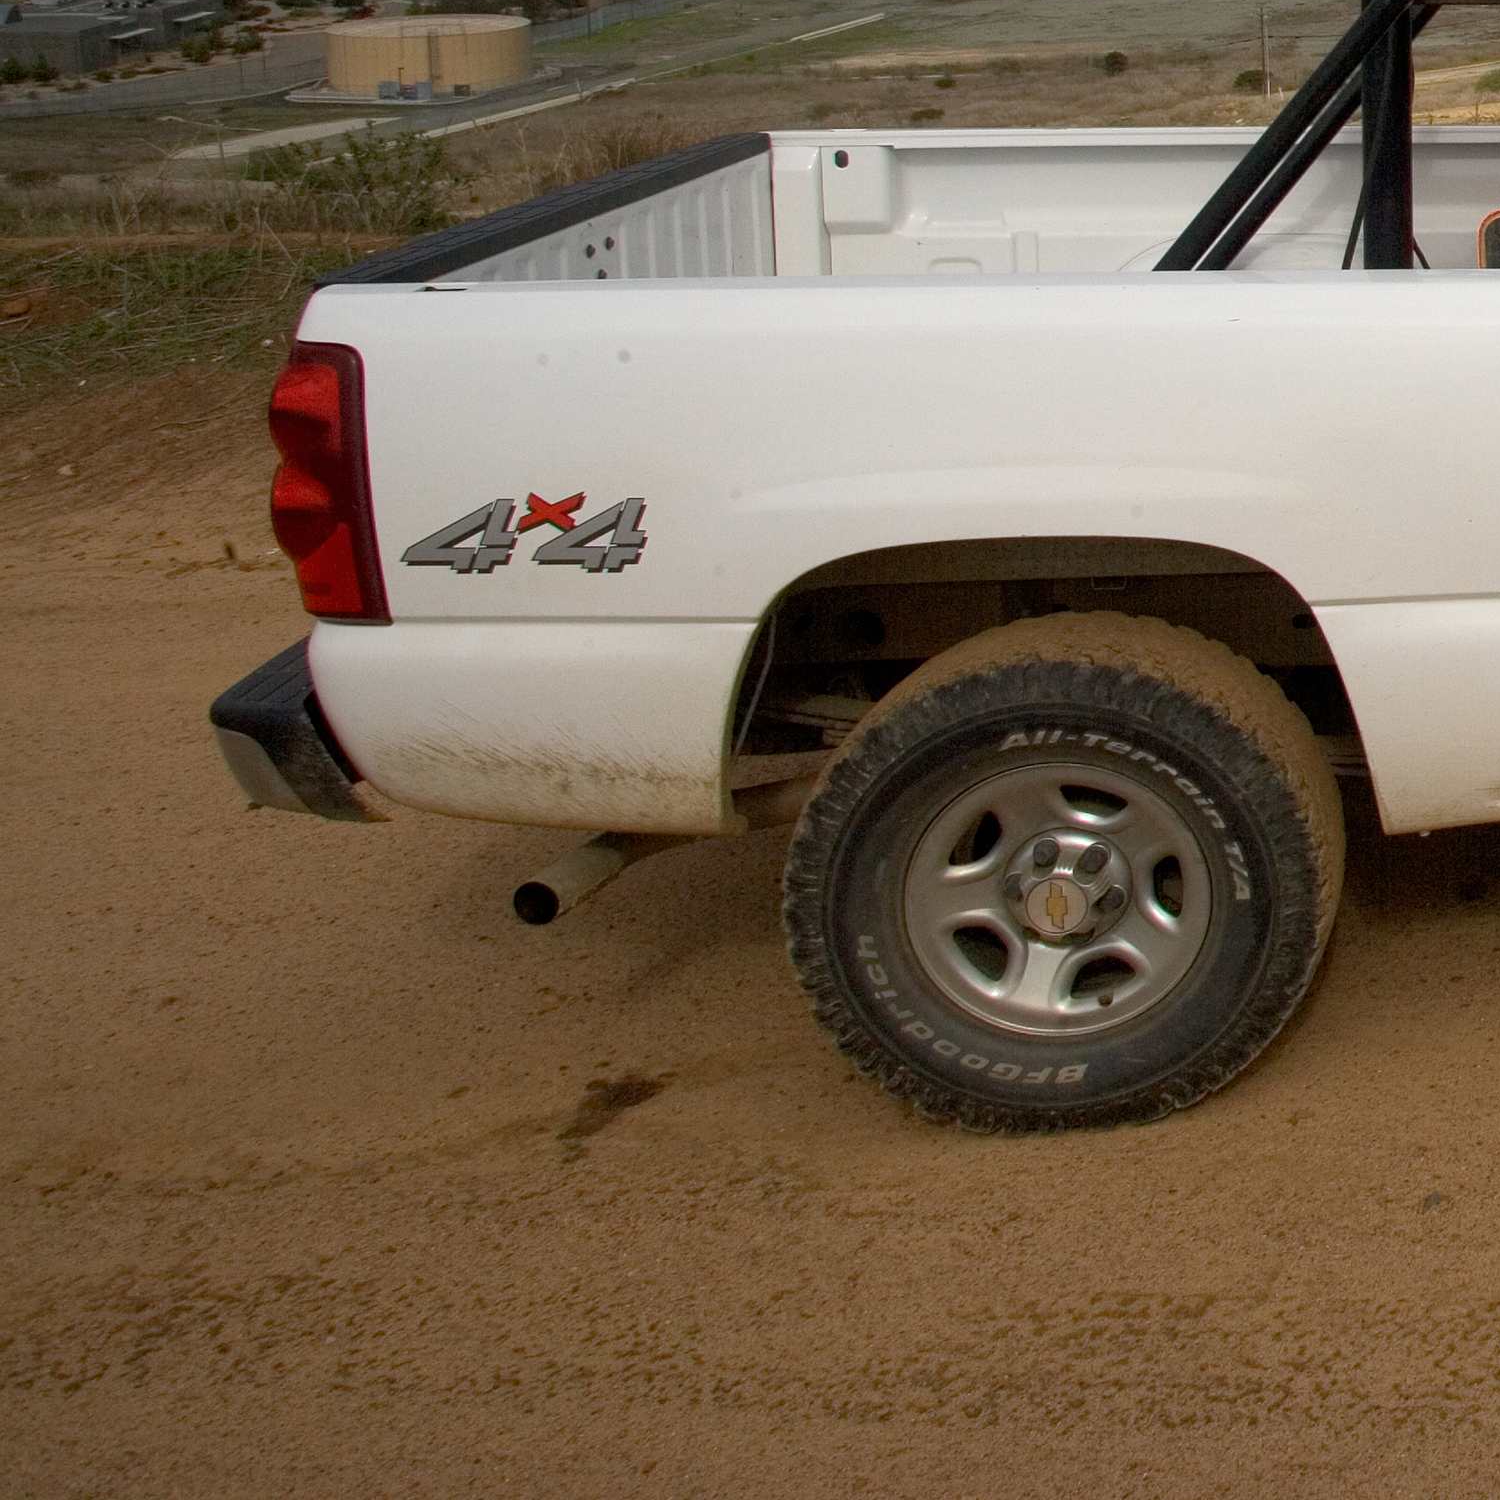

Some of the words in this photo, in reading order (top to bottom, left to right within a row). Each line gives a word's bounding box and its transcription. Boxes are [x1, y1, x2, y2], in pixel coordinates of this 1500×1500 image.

[1000, 729, 1226, 829] All-Terrain
[1224, 841, 1251, 901] T/A
[857, 934, 1089, 1085] BFGoodrich
